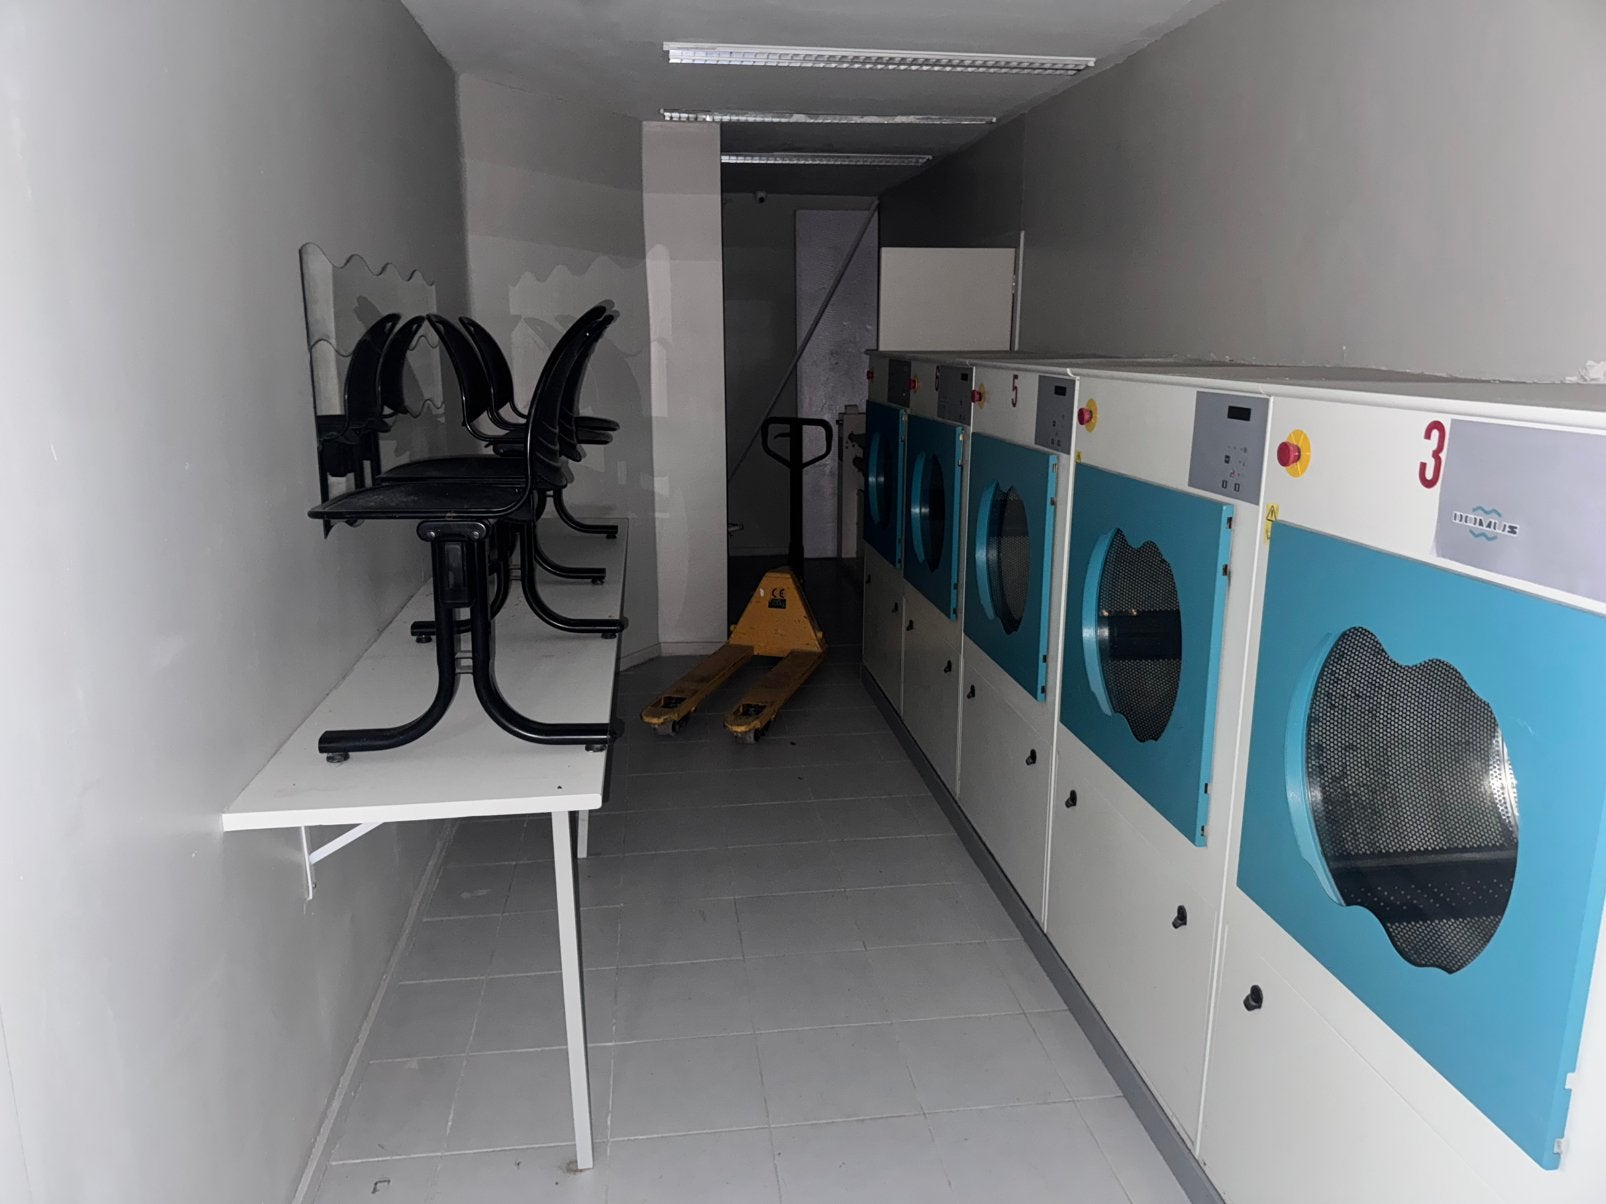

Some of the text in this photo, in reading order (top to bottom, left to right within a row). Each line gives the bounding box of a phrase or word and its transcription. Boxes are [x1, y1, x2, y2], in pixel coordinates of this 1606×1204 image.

[1011, 374, 1019, 408] 5
[1418, 420, 1447, 489] 3
[1452, 511, 1519, 536] DOMUS
